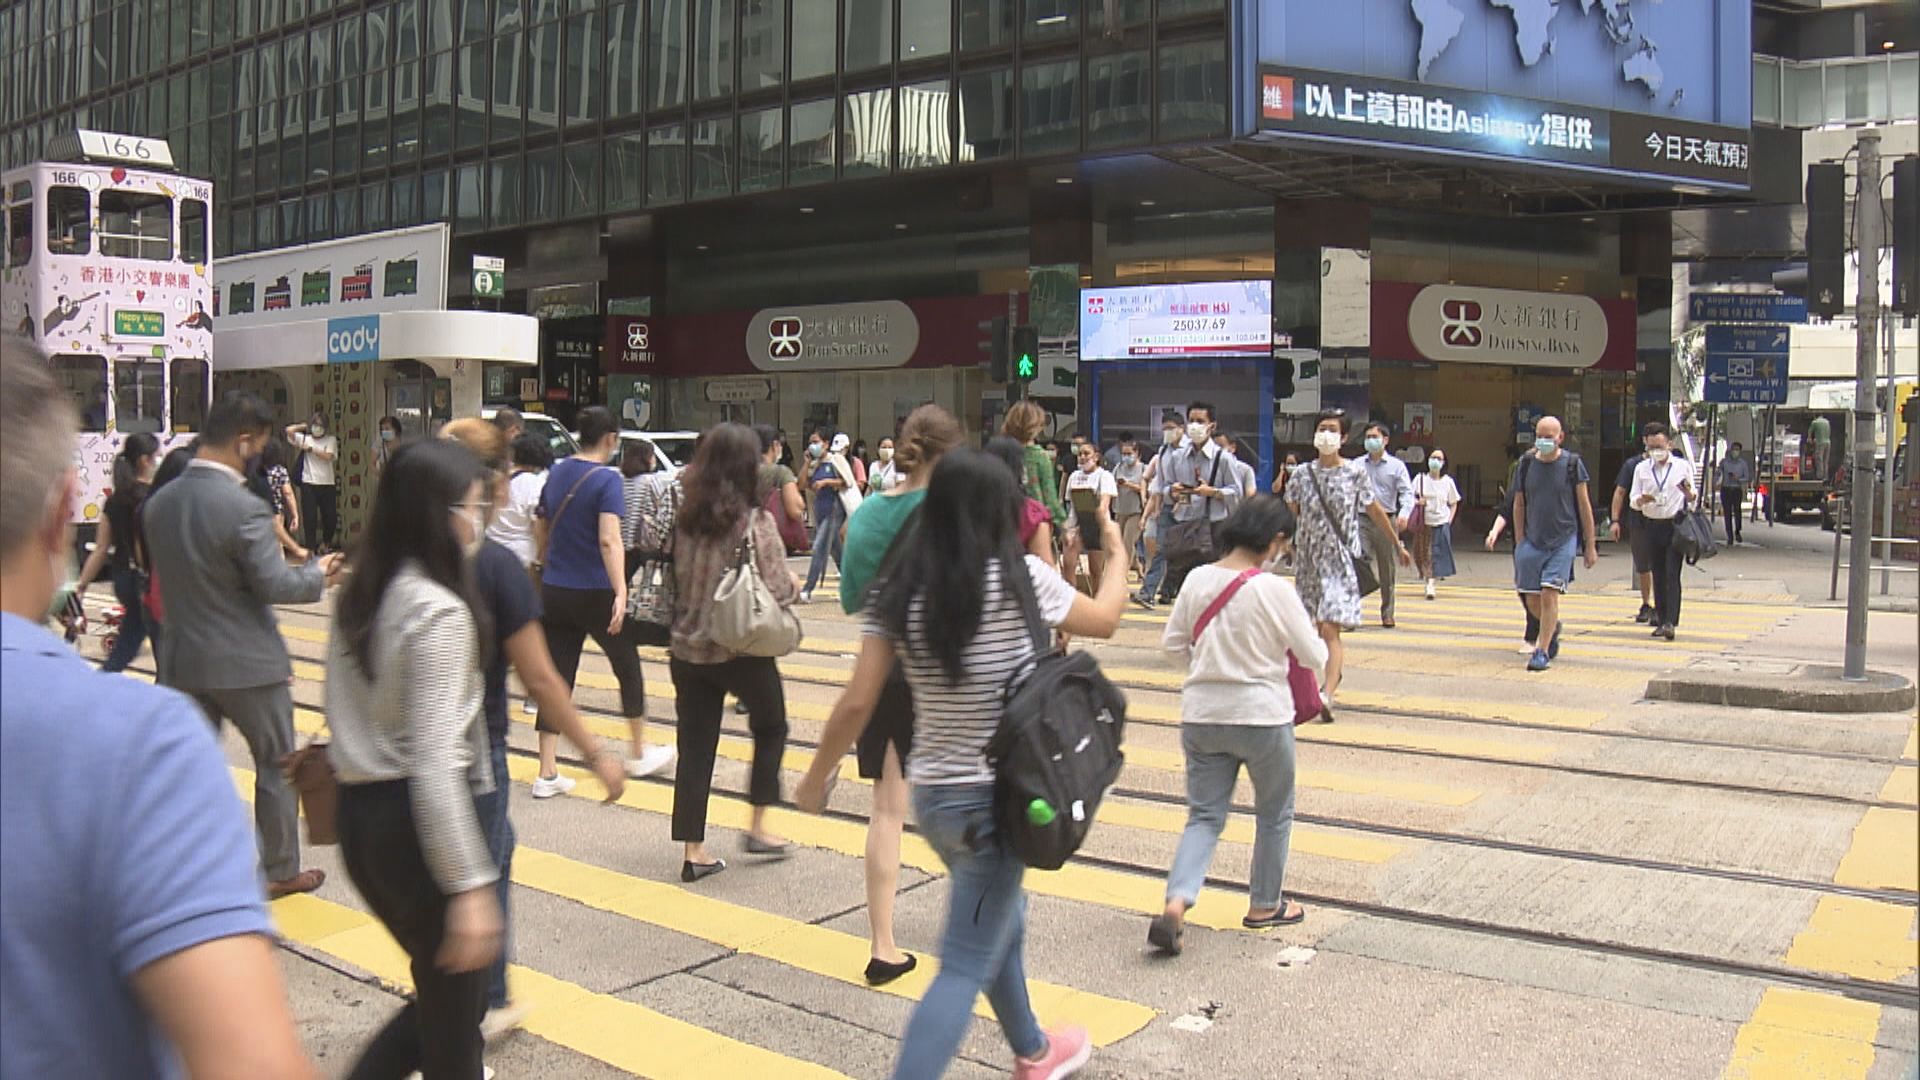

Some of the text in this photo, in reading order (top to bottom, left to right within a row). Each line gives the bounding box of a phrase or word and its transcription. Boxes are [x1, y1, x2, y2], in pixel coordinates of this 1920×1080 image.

[103, 136, 150, 159] 166
[52, 172, 76, 184] 166
[194, 187, 209, 200] 166
[81, 266, 190, 289] 香港小交響樂團
[1775, 297, 1803, 305] Station
[1173, 318, 1226, 331] 25037.69
[1494, 303, 1580, 331] 大新銀行
[329, 324, 378, 353] cody
